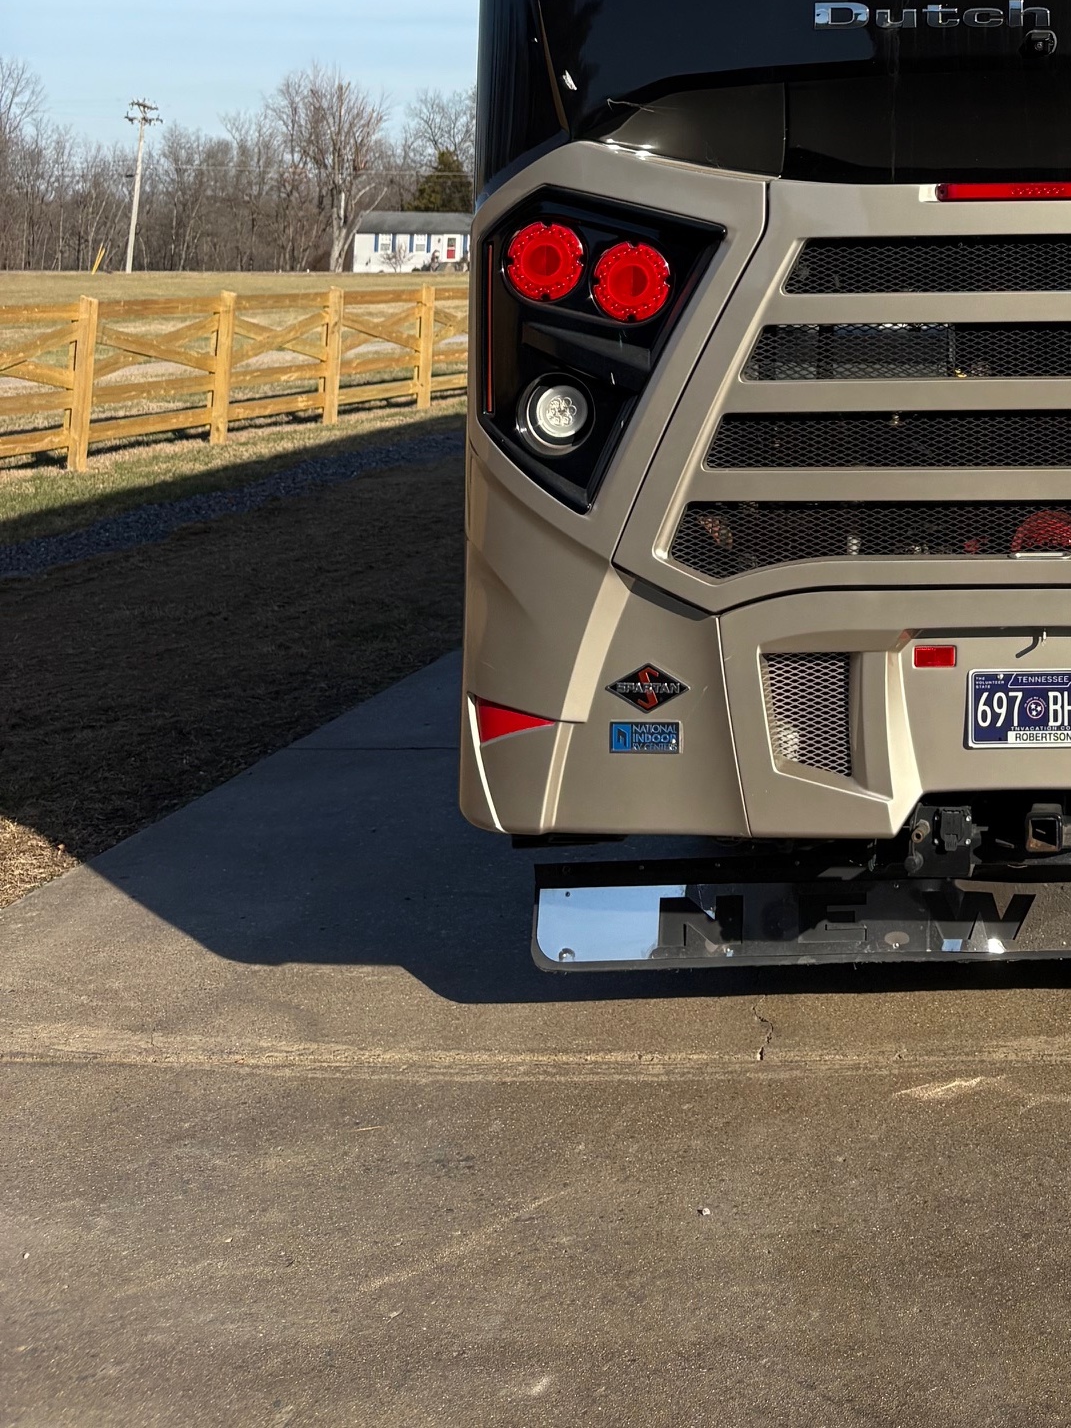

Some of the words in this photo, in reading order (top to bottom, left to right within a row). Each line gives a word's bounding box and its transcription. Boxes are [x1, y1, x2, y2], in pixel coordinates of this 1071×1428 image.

[813, 0, 1051, 30] Dutch
[1017, 675, 1070, 684] TENNESSEE
[616, 682, 681, 694] SPARTAN
[977, 691, 1023, 728] 697
[632, 724, 678, 734] NATIONAL
[632, 733, 677, 743] INDOOR
